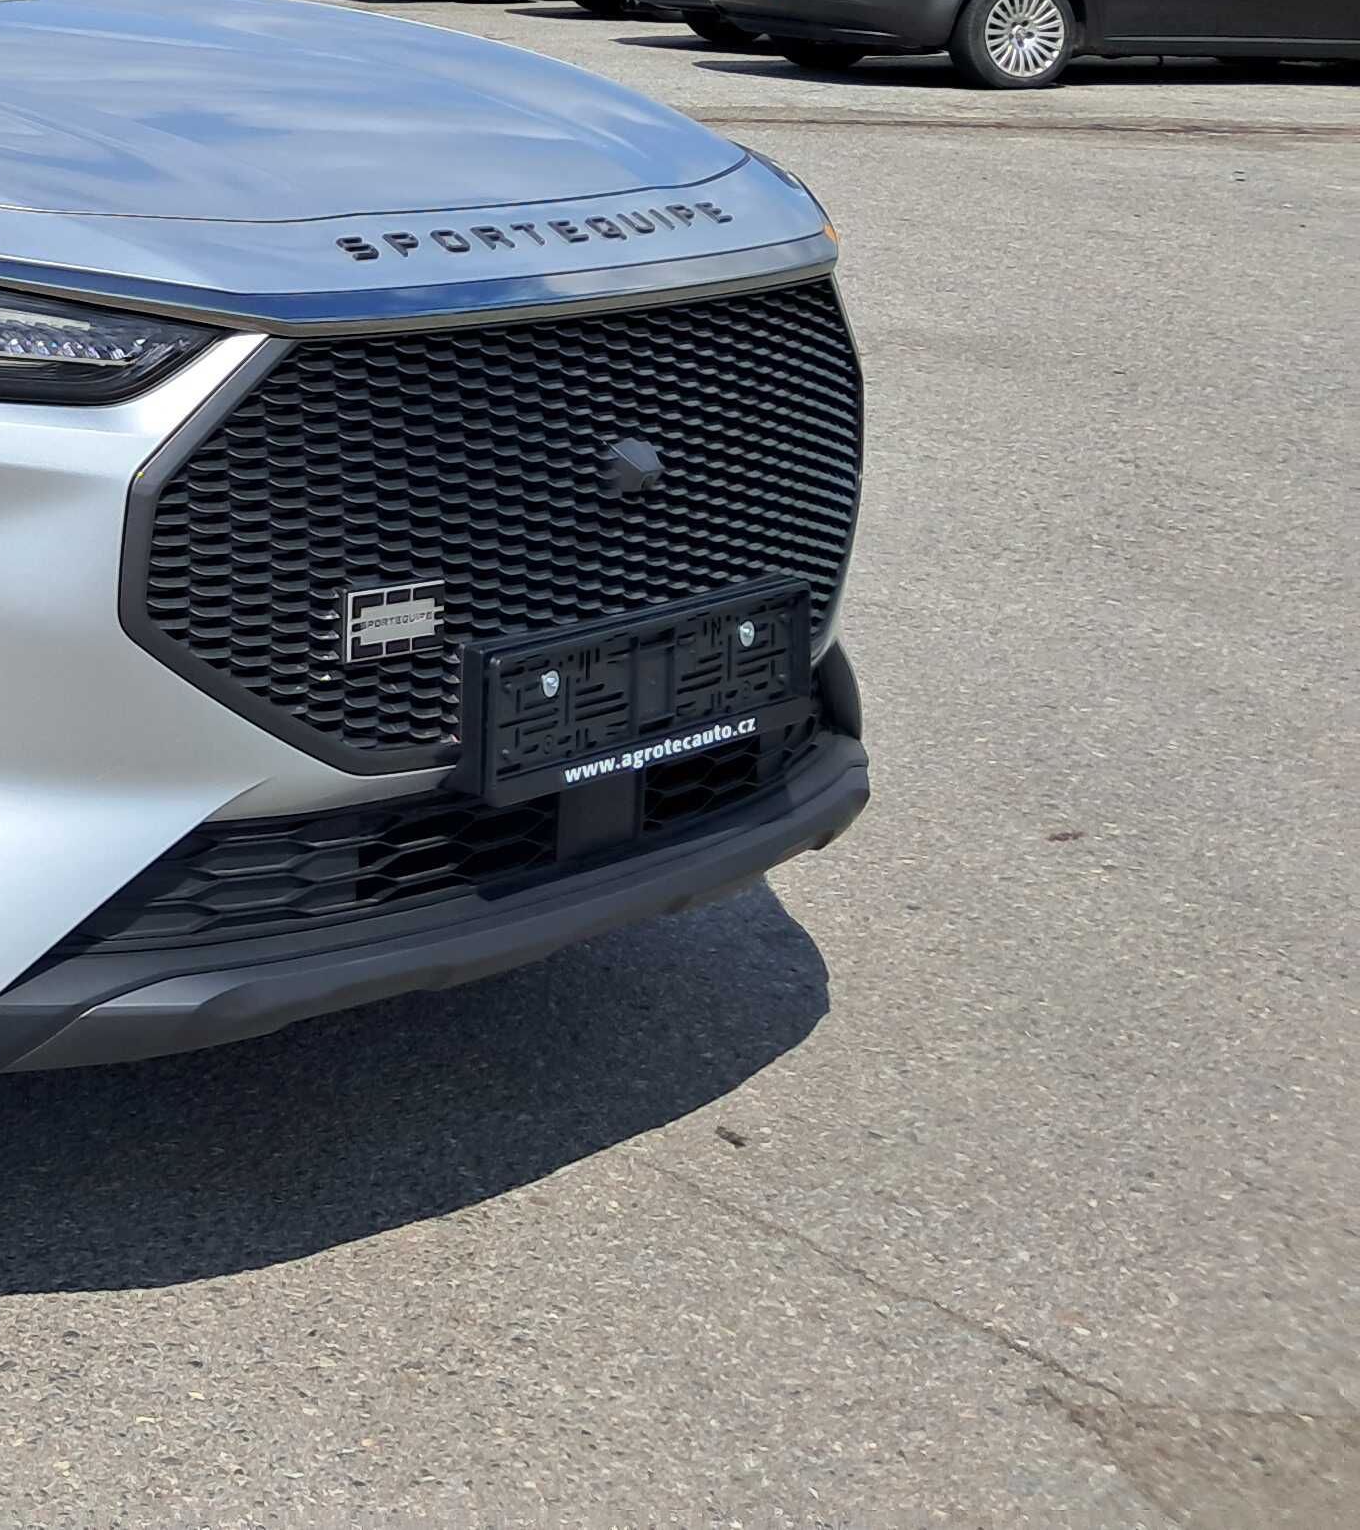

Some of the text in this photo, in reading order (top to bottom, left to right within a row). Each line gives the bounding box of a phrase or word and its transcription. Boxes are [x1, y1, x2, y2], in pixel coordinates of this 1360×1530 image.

[336, 201, 734, 262] SPORTEQUIPE
[359, 611, 434, 631] SPORTEQUIPE
[564, 717, 757, 784] www.agrotecauto.cz
